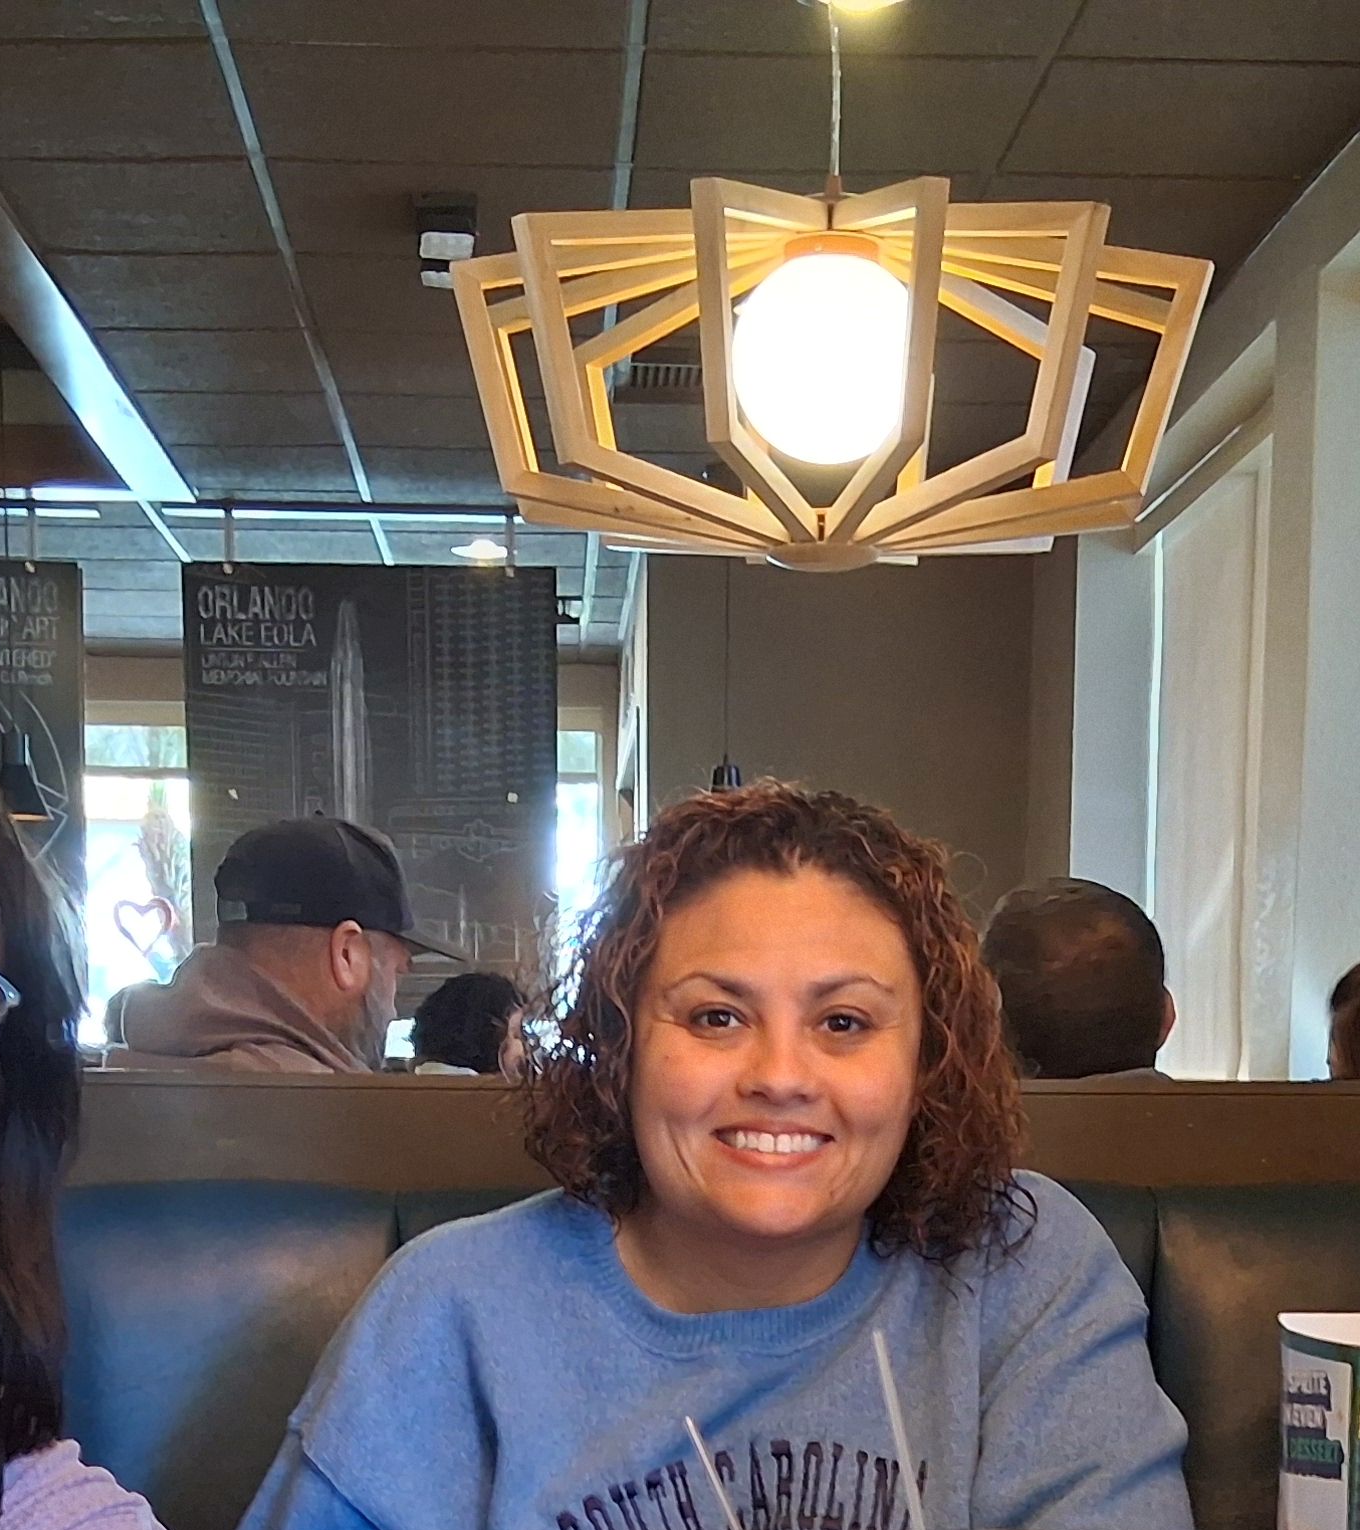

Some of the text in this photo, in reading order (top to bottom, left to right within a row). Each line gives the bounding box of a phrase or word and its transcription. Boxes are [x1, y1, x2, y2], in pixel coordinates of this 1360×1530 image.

[197, 584, 315, 621] ORLANDO
[22, 615, 60, 641] ART
[200, 622, 318, 647] LAKE EOLA
